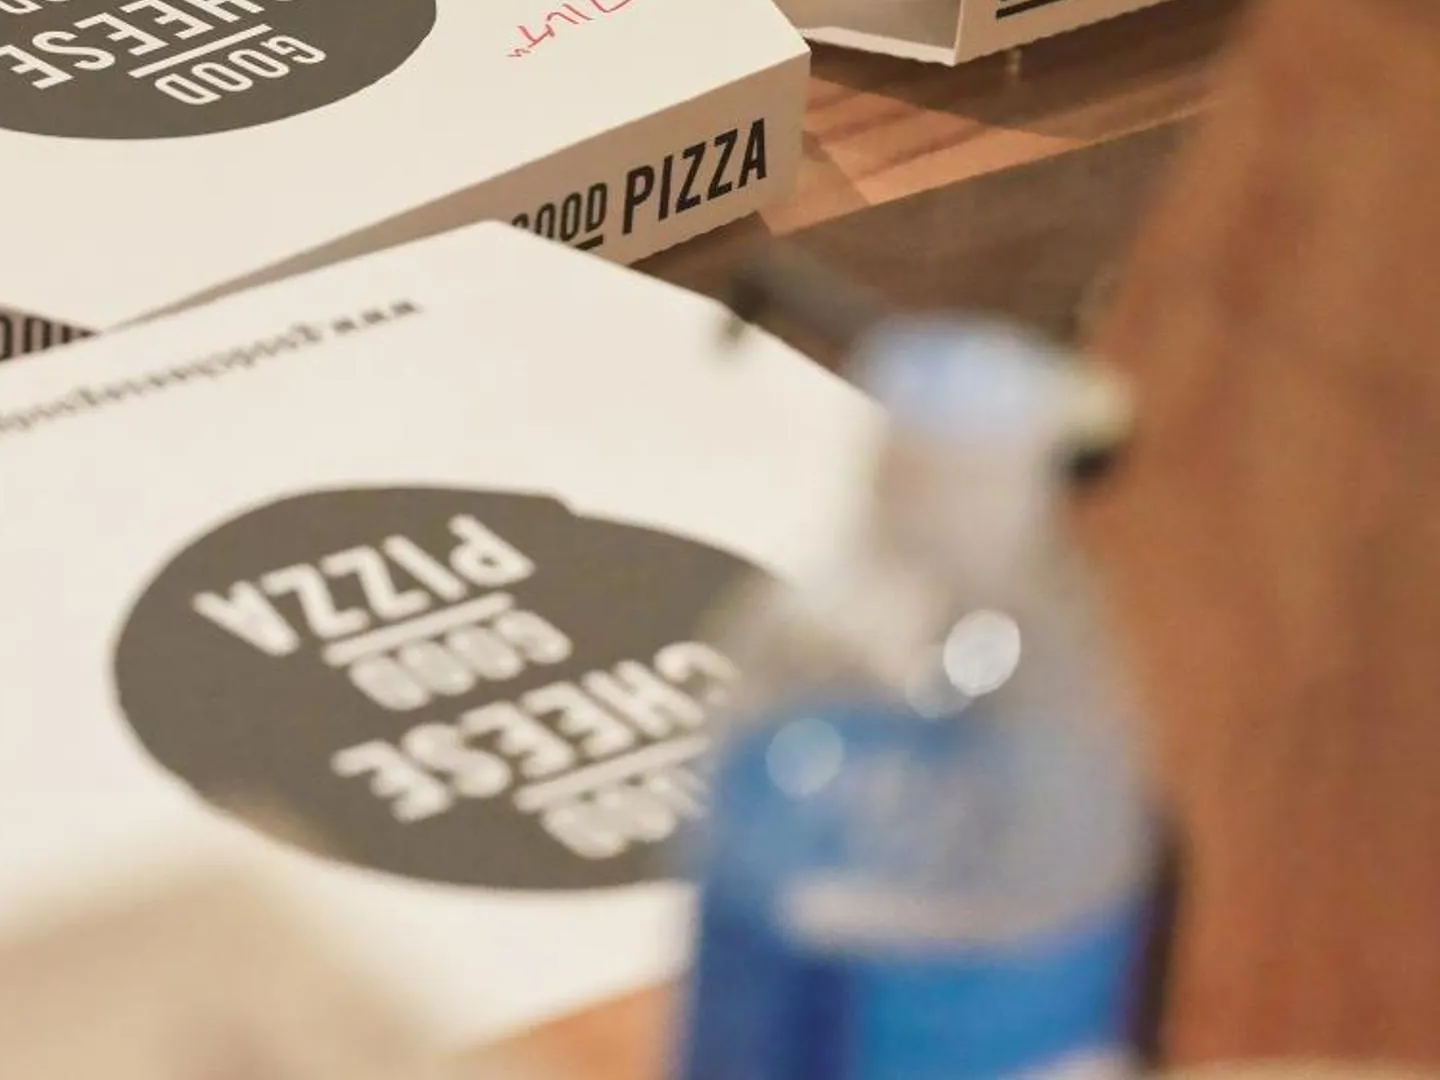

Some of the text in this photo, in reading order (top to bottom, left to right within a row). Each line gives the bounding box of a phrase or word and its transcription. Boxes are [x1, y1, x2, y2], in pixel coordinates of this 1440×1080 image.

[155, 35, 327, 105] GOOD
[511, 118, 767, 243] OOD PIZZA
[192, 514, 536, 657] PIZZA
[331, 640, 736, 822] CHEESE
